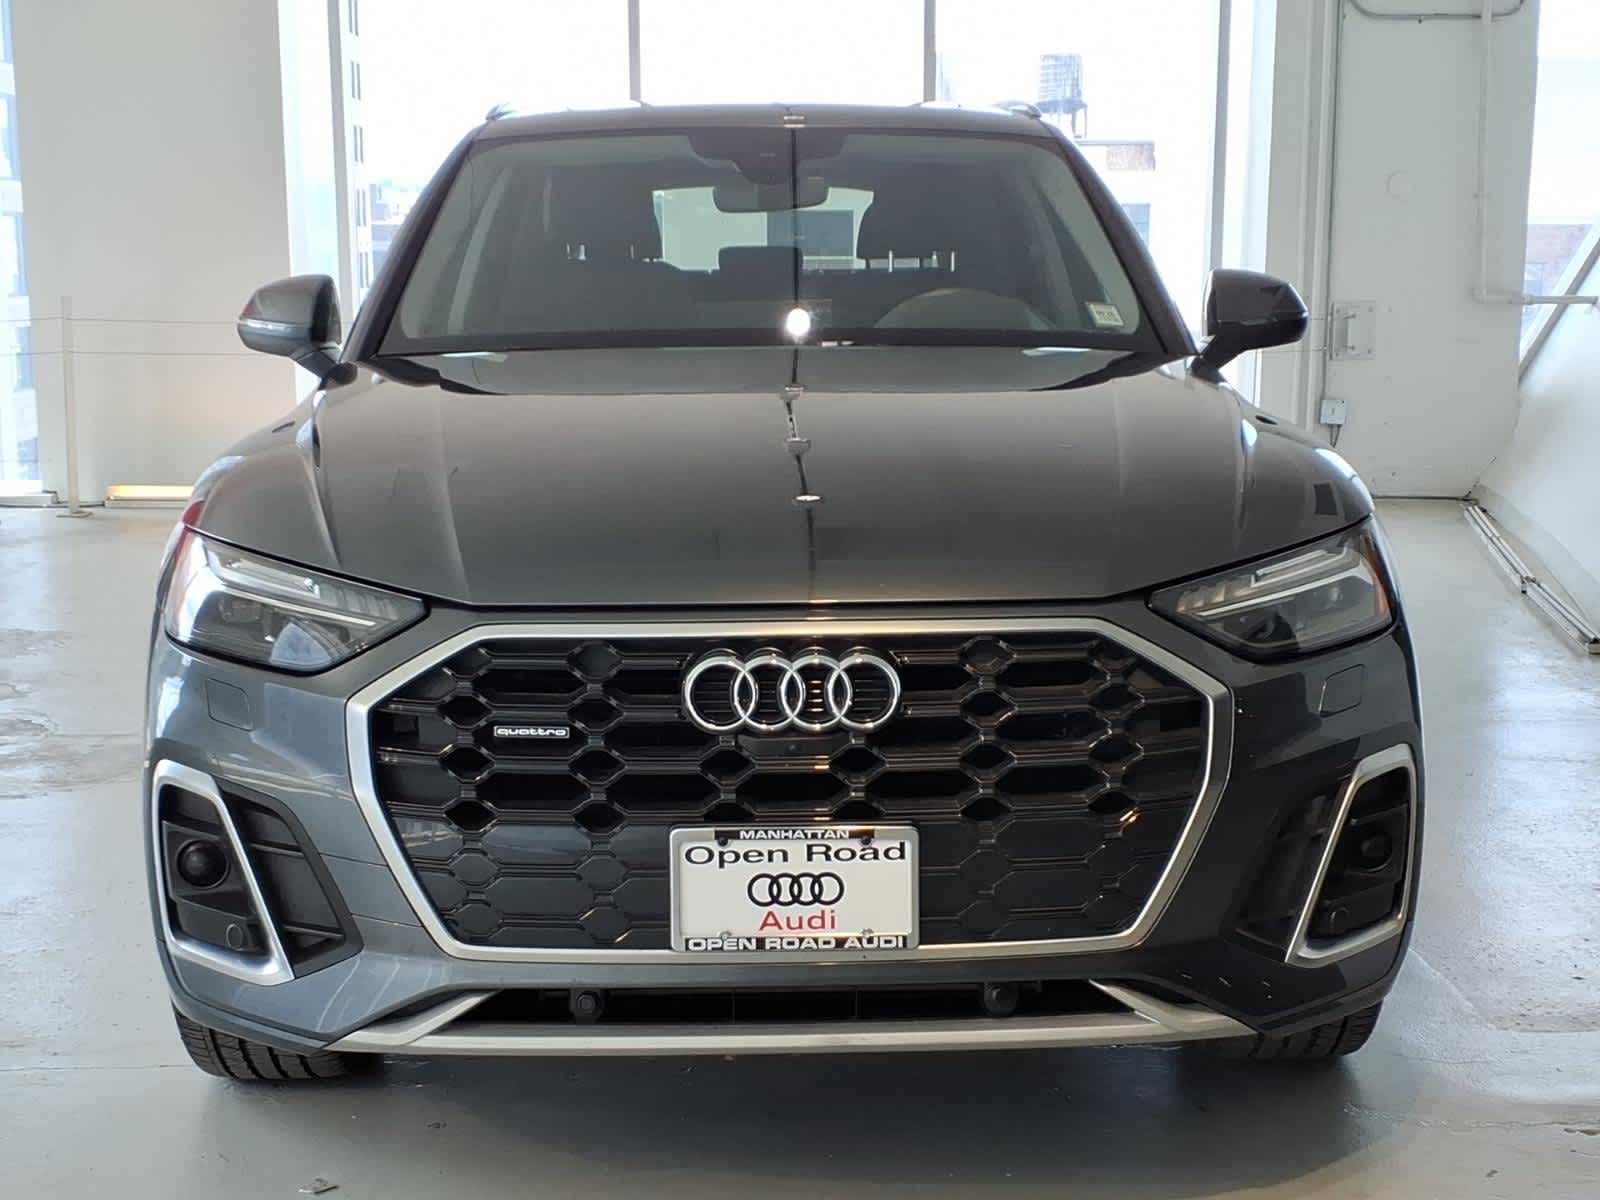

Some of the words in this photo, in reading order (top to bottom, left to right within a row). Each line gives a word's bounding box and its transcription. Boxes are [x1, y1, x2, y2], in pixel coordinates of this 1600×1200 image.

[496, 727, 567, 736] quattro
[739, 829, 849, 840] MANHATTAN
[685, 846, 789, 869] Open
[806, 841, 906, 862] Road
[759, 910, 836, 931] Audi
[688, 937, 757, 951] OPEN
[764, 937, 836, 950] ROAD
[845, 935, 903, 949] AUDI
